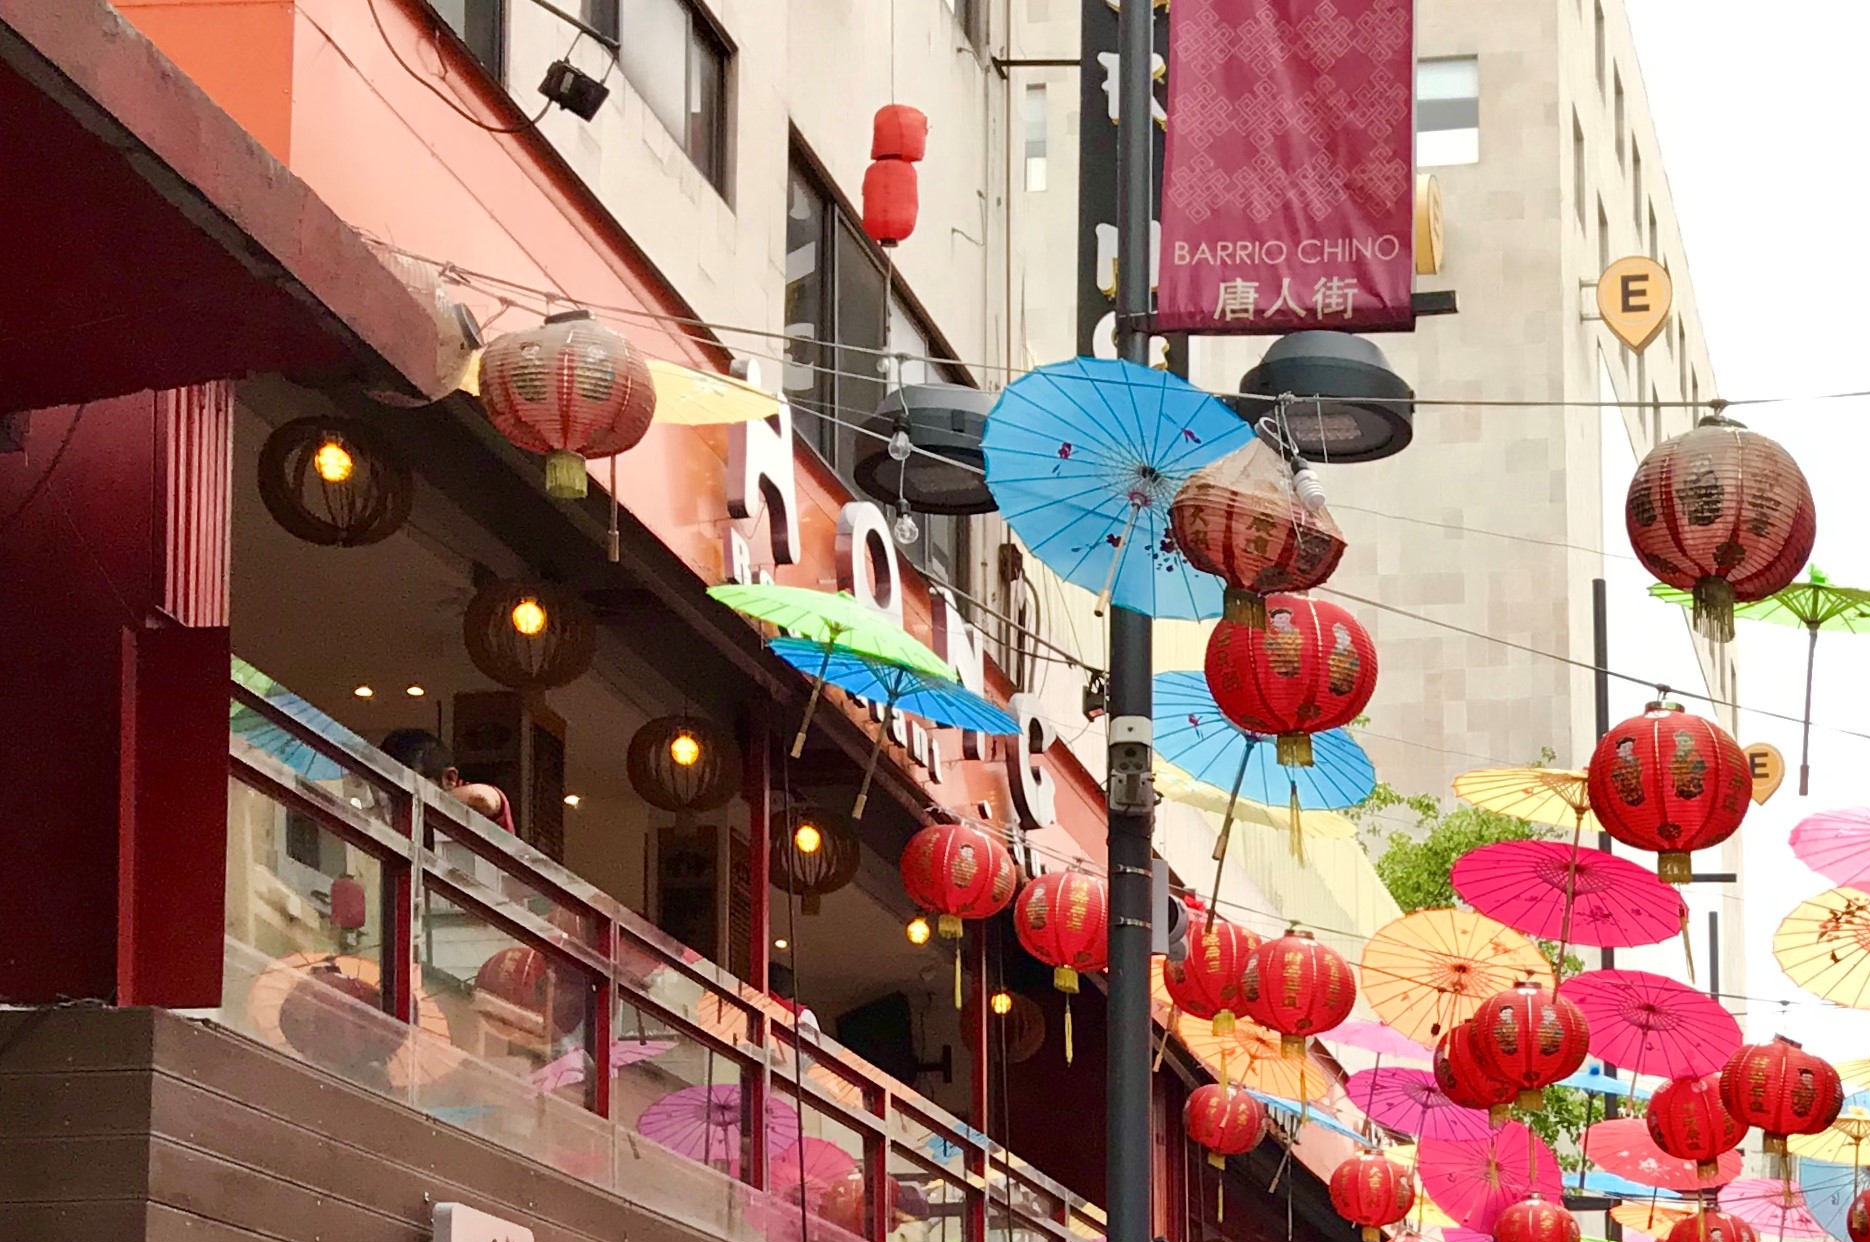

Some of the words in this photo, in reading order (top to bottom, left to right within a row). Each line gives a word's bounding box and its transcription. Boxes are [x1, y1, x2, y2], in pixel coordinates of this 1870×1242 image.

[1174, 241, 1287, 265] BARRIO
[1298, 234, 1399, 262] CHINO
[1213, 276, 1357, 323] 唐人街
[1620, 274, 1650, 313] E
